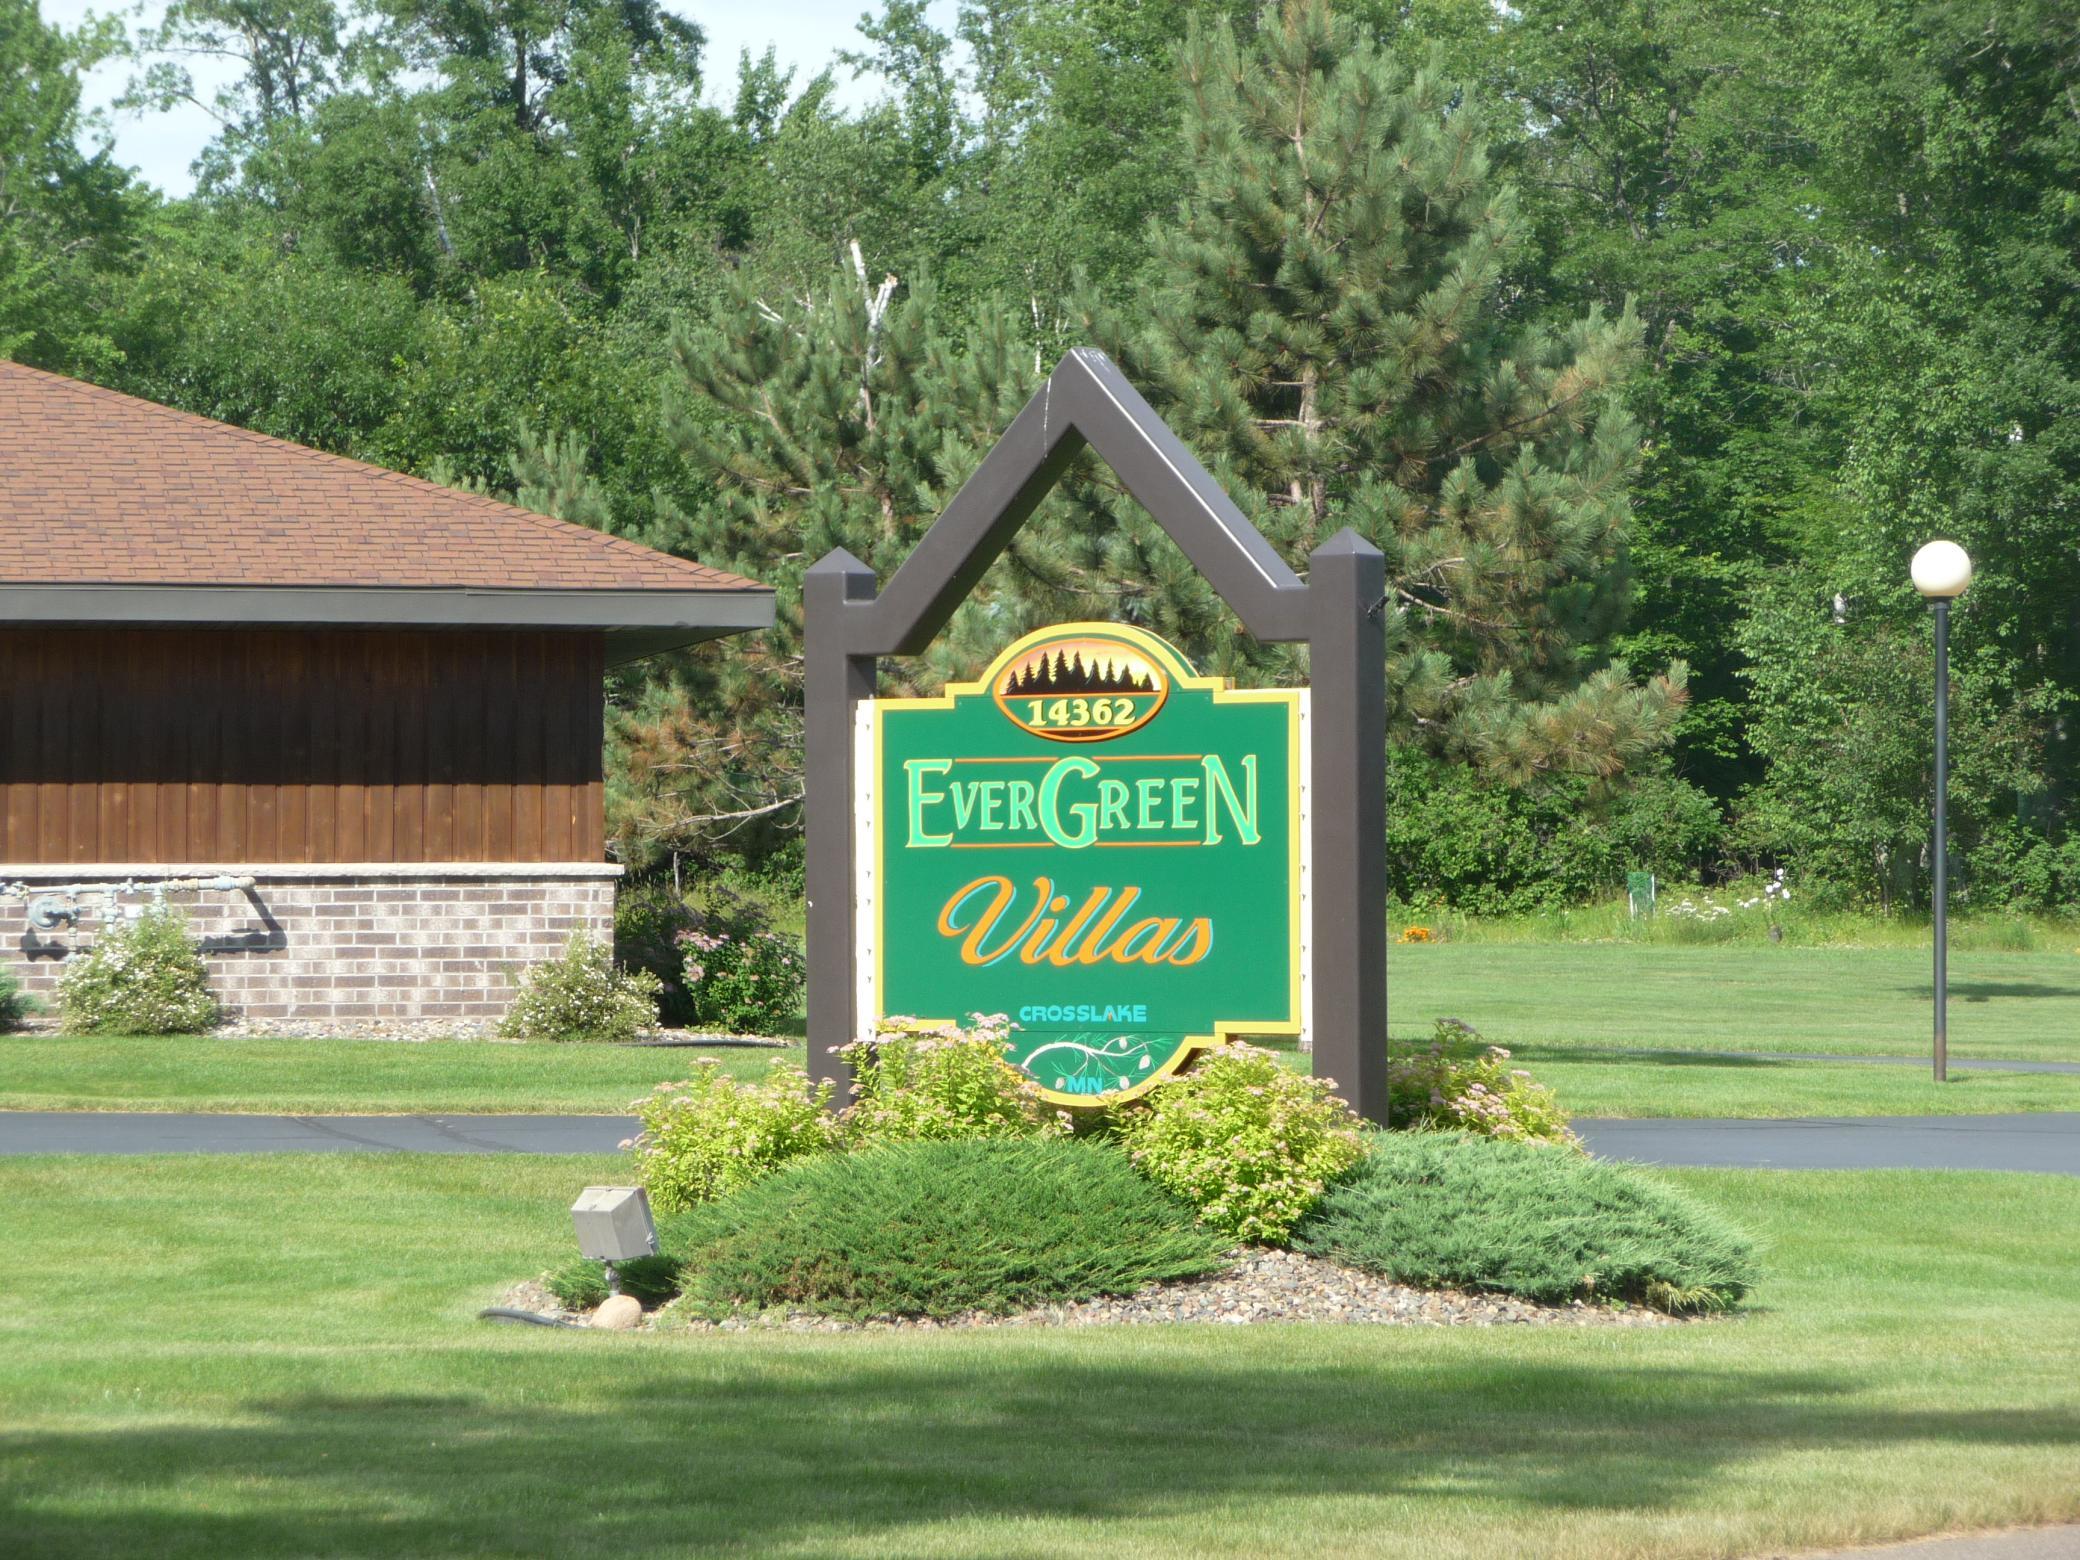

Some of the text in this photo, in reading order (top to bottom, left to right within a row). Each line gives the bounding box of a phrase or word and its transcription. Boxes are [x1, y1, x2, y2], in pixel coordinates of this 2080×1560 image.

[1027, 697, 1136, 728] 14362
[903, 754, 1262, 849] EVERGREEN
[937, 874, 1215, 968] Villas
[1019, 1004, 1148, 1024] CROSSLAKE
[1066, 1077, 1104, 1095] MN
